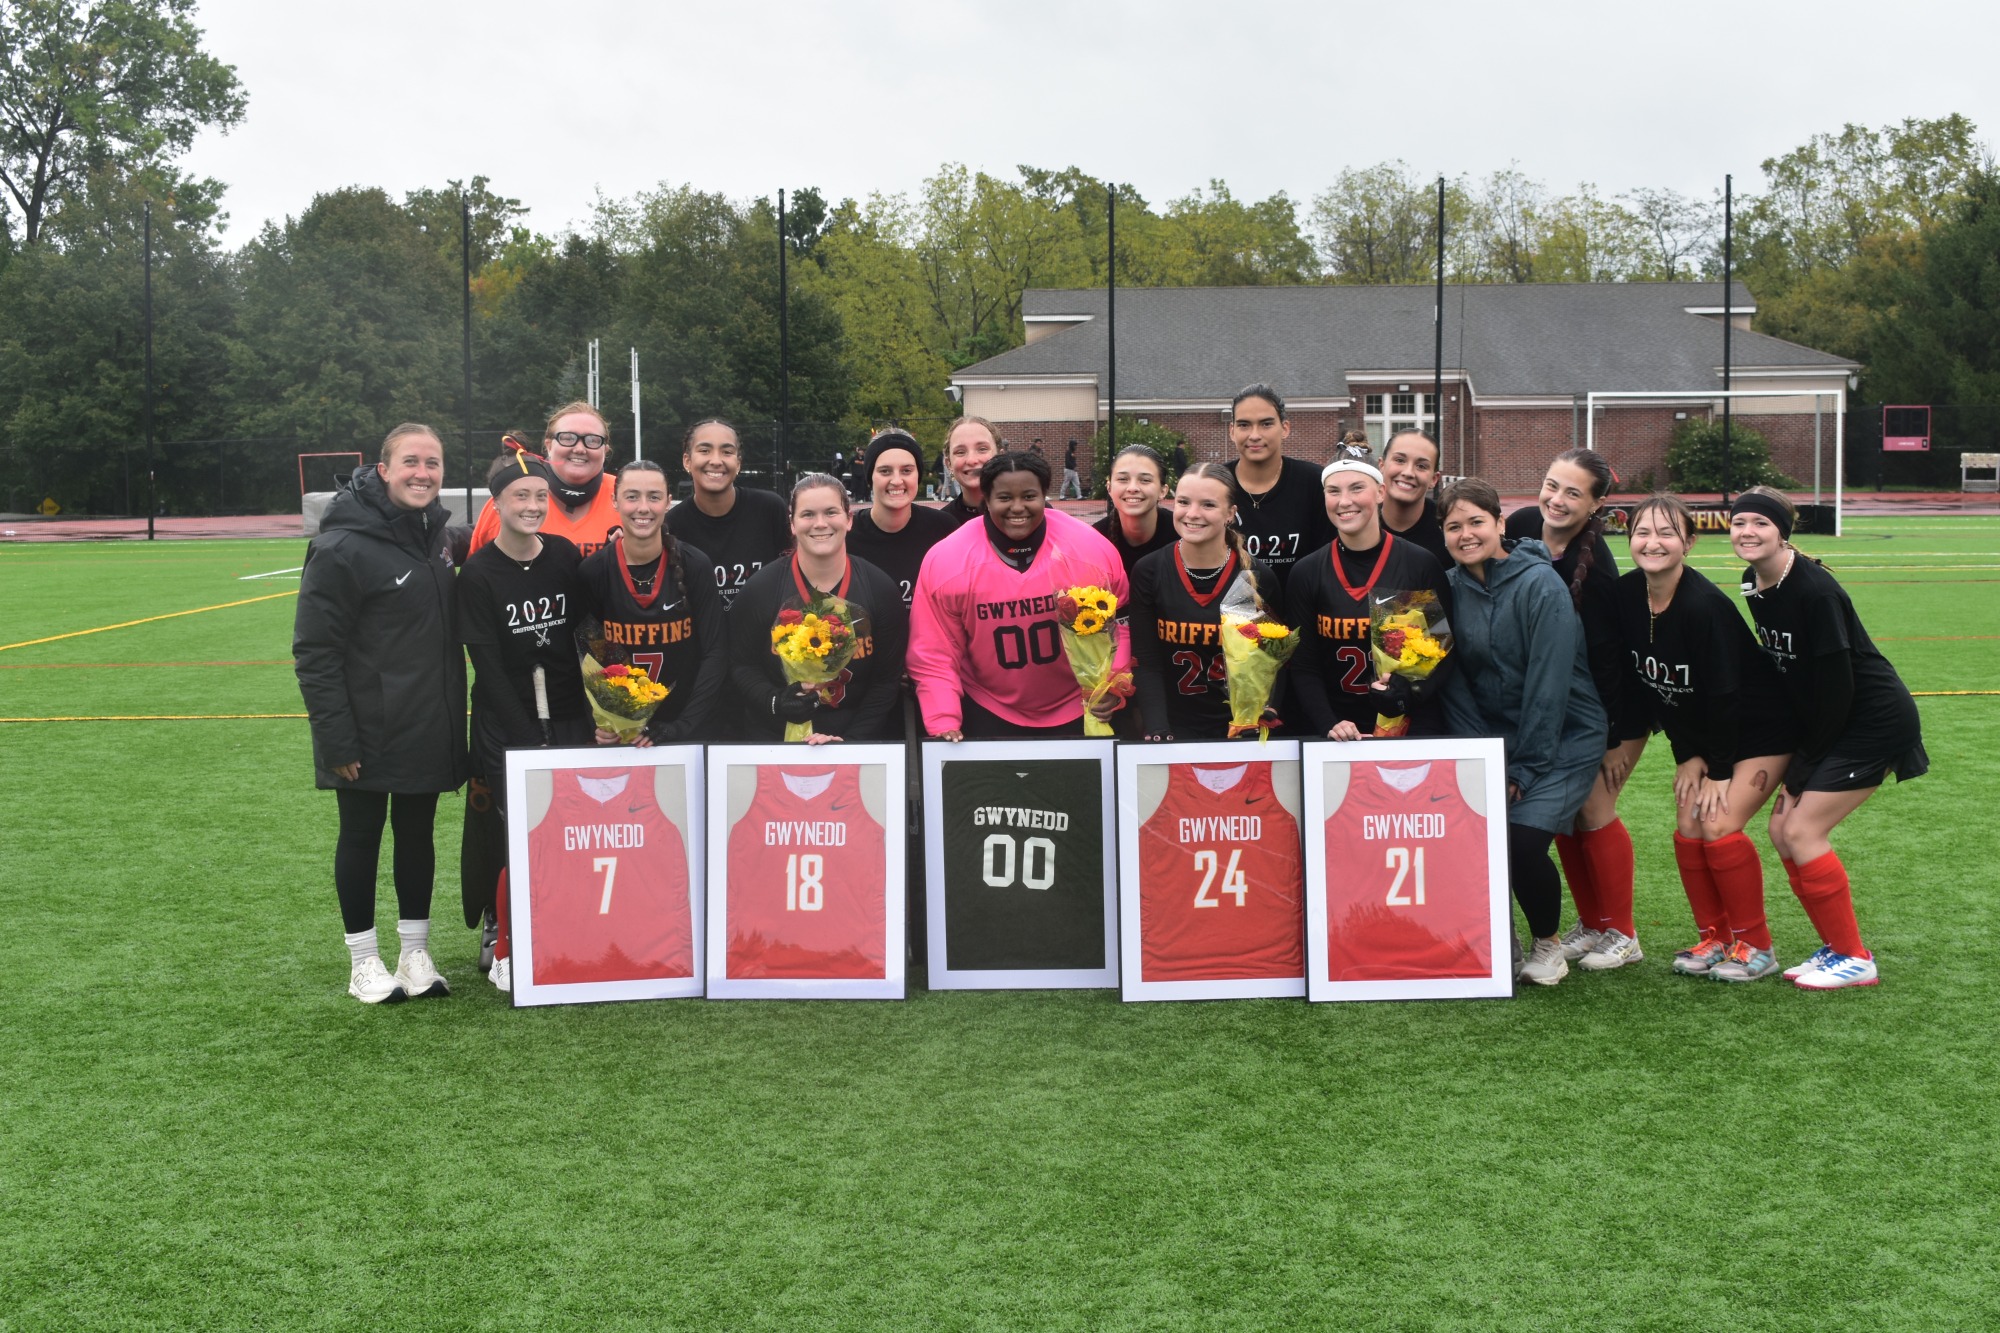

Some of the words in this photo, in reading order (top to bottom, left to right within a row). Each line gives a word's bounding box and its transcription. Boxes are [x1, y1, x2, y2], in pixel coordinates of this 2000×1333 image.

[1247, 533, 1300, 557] 027
[714, 561, 762, 587] 027
[506, 593, 566, 627] 2027
[976, 594, 1056, 621] GWYNED
[512, 624, 536, 635] GRIFFINS
[535, 622, 548, 631] FIELD
[603, 617, 692, 645] GRIFFINS
[1157, 618, 1224, 646] GRIFFI
[993, 619, 1061, 670] 00
[632, 652, 664, 684] 7
[1335, 646, 1374, 695] 2
[1631, 649, 1689, 686] 2027
[973, 806, 1069, 832] GWYNEDD
[1179, 815, 1262, 843] GWYNEDD
[1363, 813, 1445, 840] GWYNEDD
[564, 823, 644, 851] GWYNEDD
[764, 821, 847, 847] GWYNEDD
[982, 833, 1056, 891] 00
[593, 856, 618, 915] 7
[785, 853, 824, 912] 18
[1193, 848, 1249, 909] 24
[1385, 846, 1426, 907] 21
